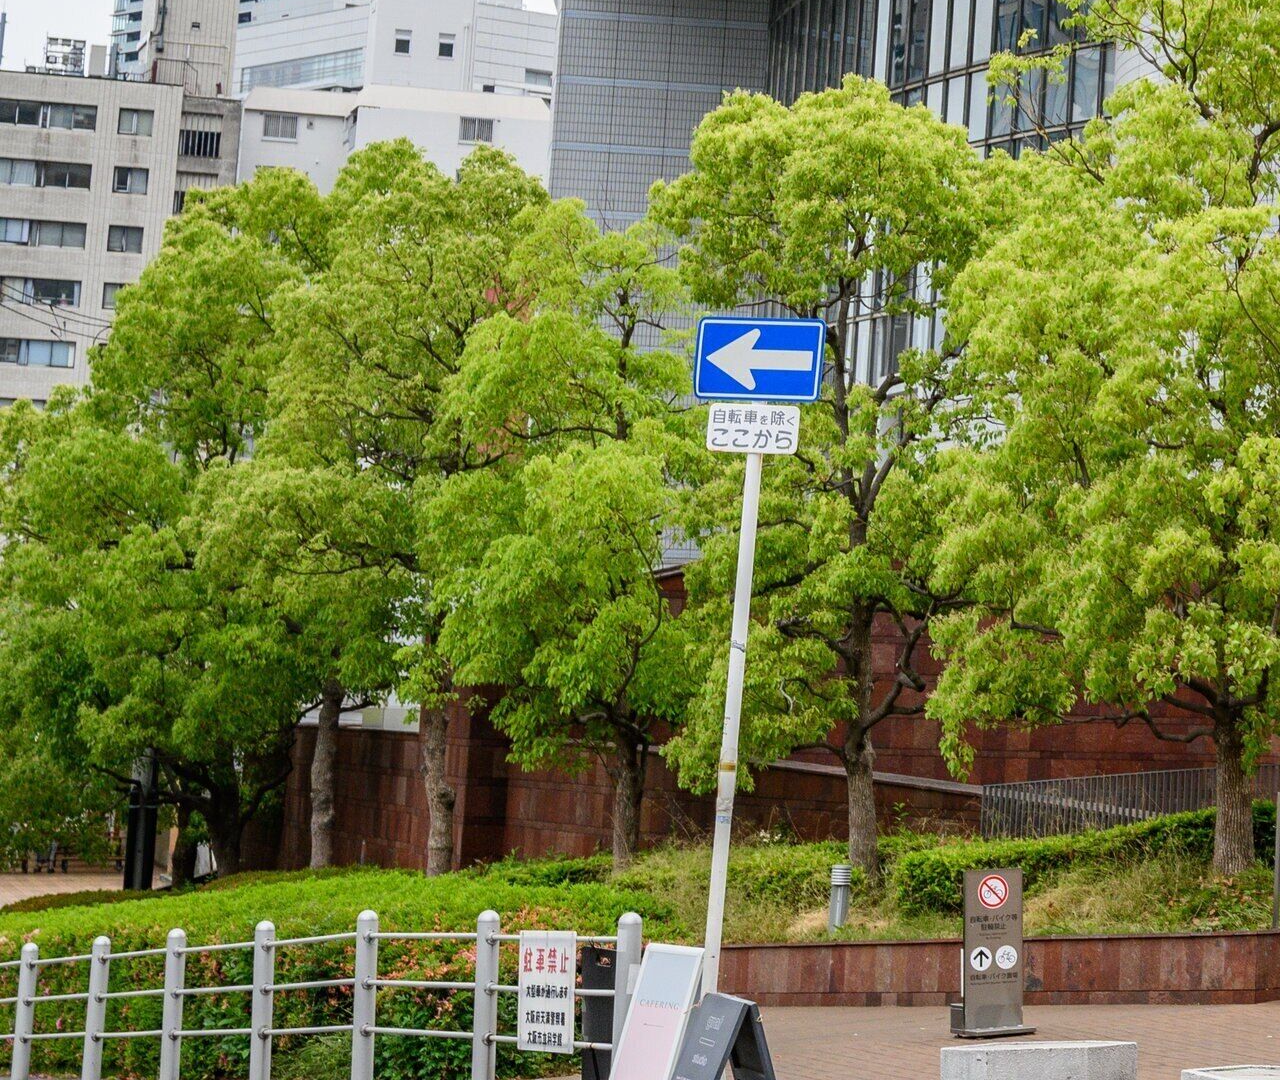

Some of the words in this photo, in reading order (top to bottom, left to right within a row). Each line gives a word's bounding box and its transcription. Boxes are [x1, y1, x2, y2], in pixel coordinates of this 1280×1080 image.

[713, 408, 795, 426] 自転車を除く
[711, 428, 793, 449] ここから
[523, 948, 569, 974] 駐車禁止
[640, 999, 680, 1011] CAFERING
[527, 1031, 563, 1047] 大阪市立科学館
